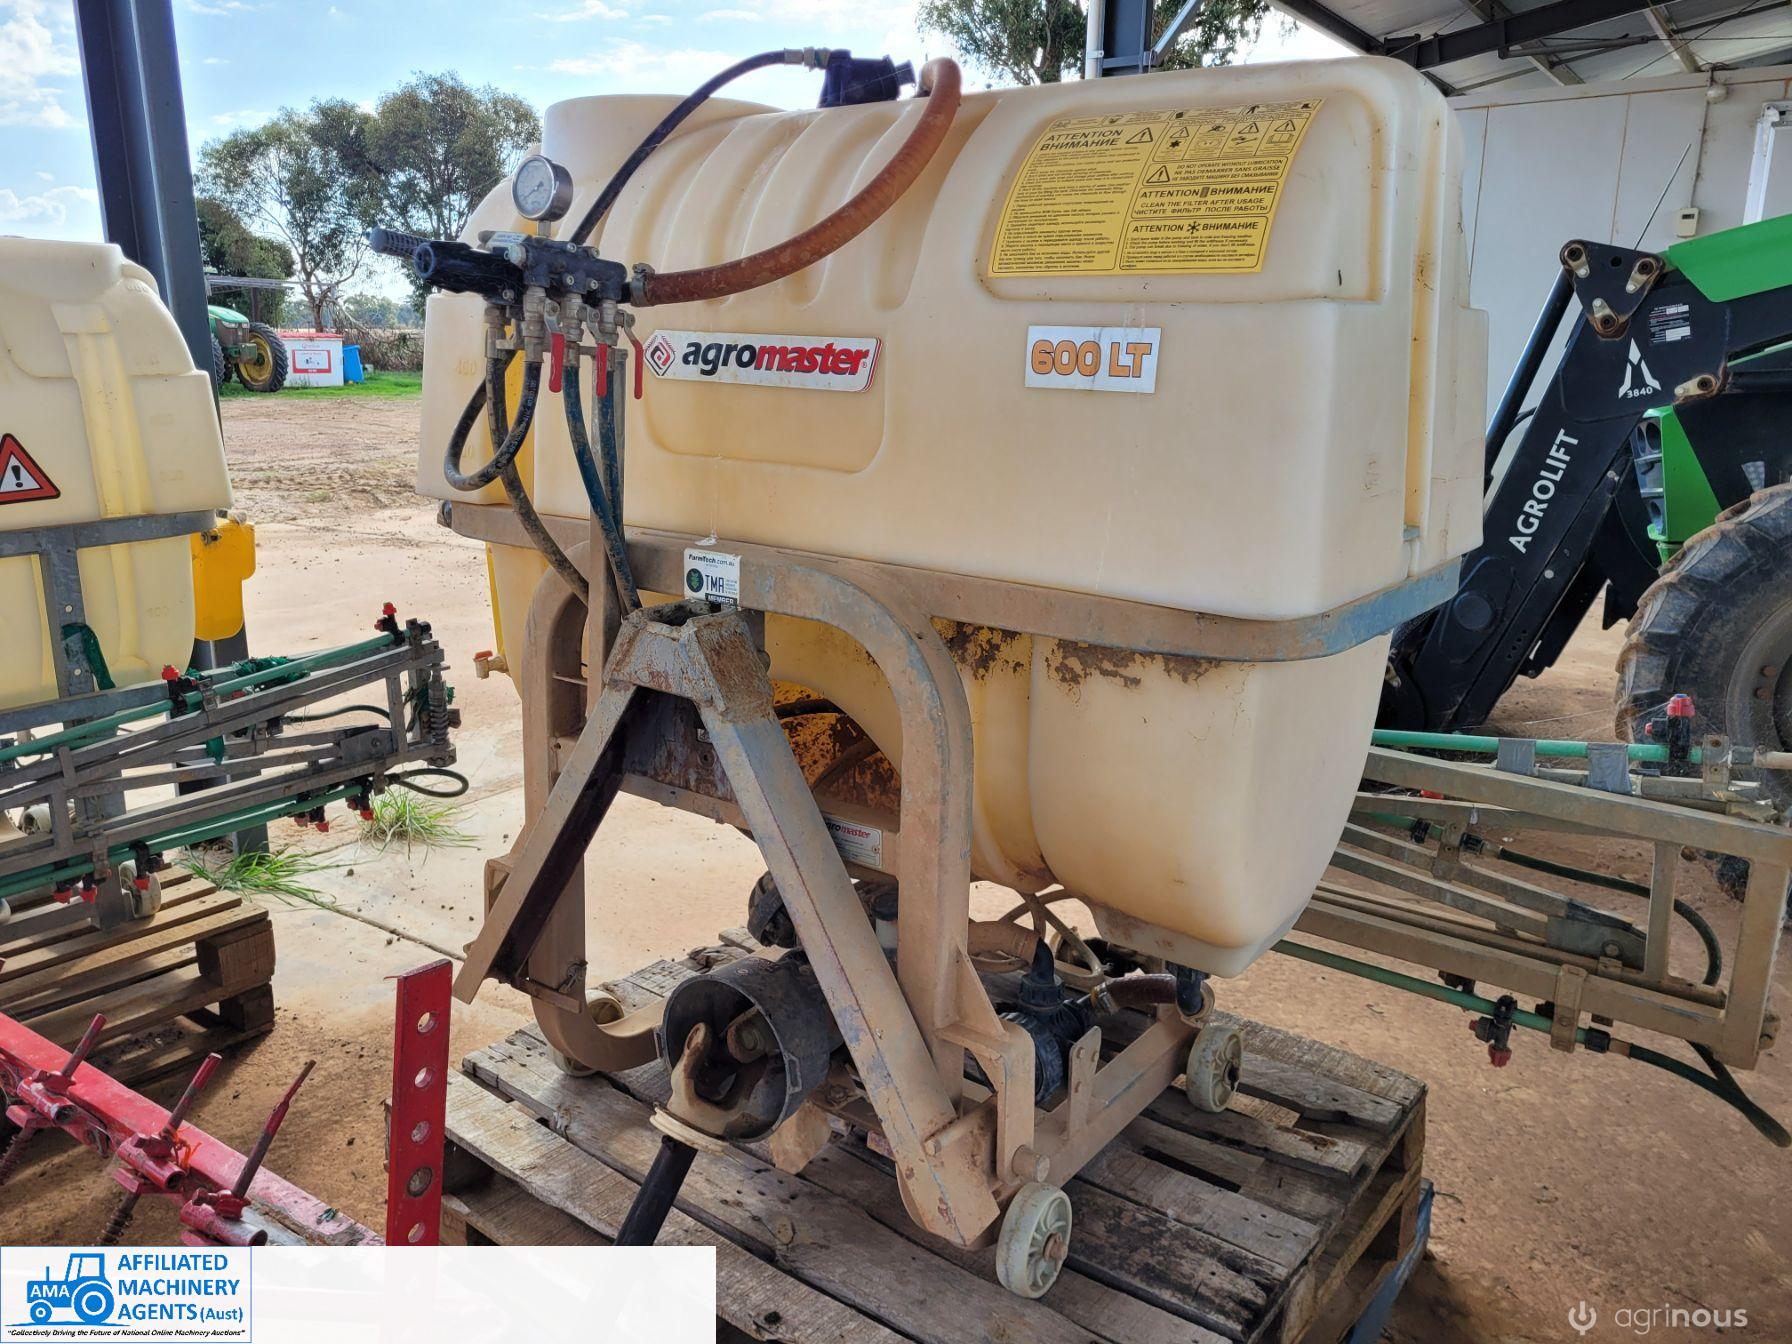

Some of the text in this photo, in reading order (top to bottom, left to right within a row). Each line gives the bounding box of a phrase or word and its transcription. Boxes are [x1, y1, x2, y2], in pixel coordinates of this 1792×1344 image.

[1046, 130, 1124, 142] ATTENTION
[1040, 137, 1121, 151] ВНИМАНИЕ
[1247, 159, 1284, 167] LUBRICATION
[1140, 187, 1200, 198] ATTENTION
[1210, 185, 1275, 195] ВНИМАНИЕ
[1132, 224, 1184, 233] ATTENTION
[1202, 221, 1259, 230] ВНИМАНИЕ
[682, 341, 869, 376] agromaster
[1031, 339, 1152, 378] 600 LT
[1626, 386, 1653, 399] 3840
[1508, 427, 1579, 554] AGROLIFT
[688, 553, 735, 567] FarmTech.com.au
[705, 574, 725, 594] TMA
